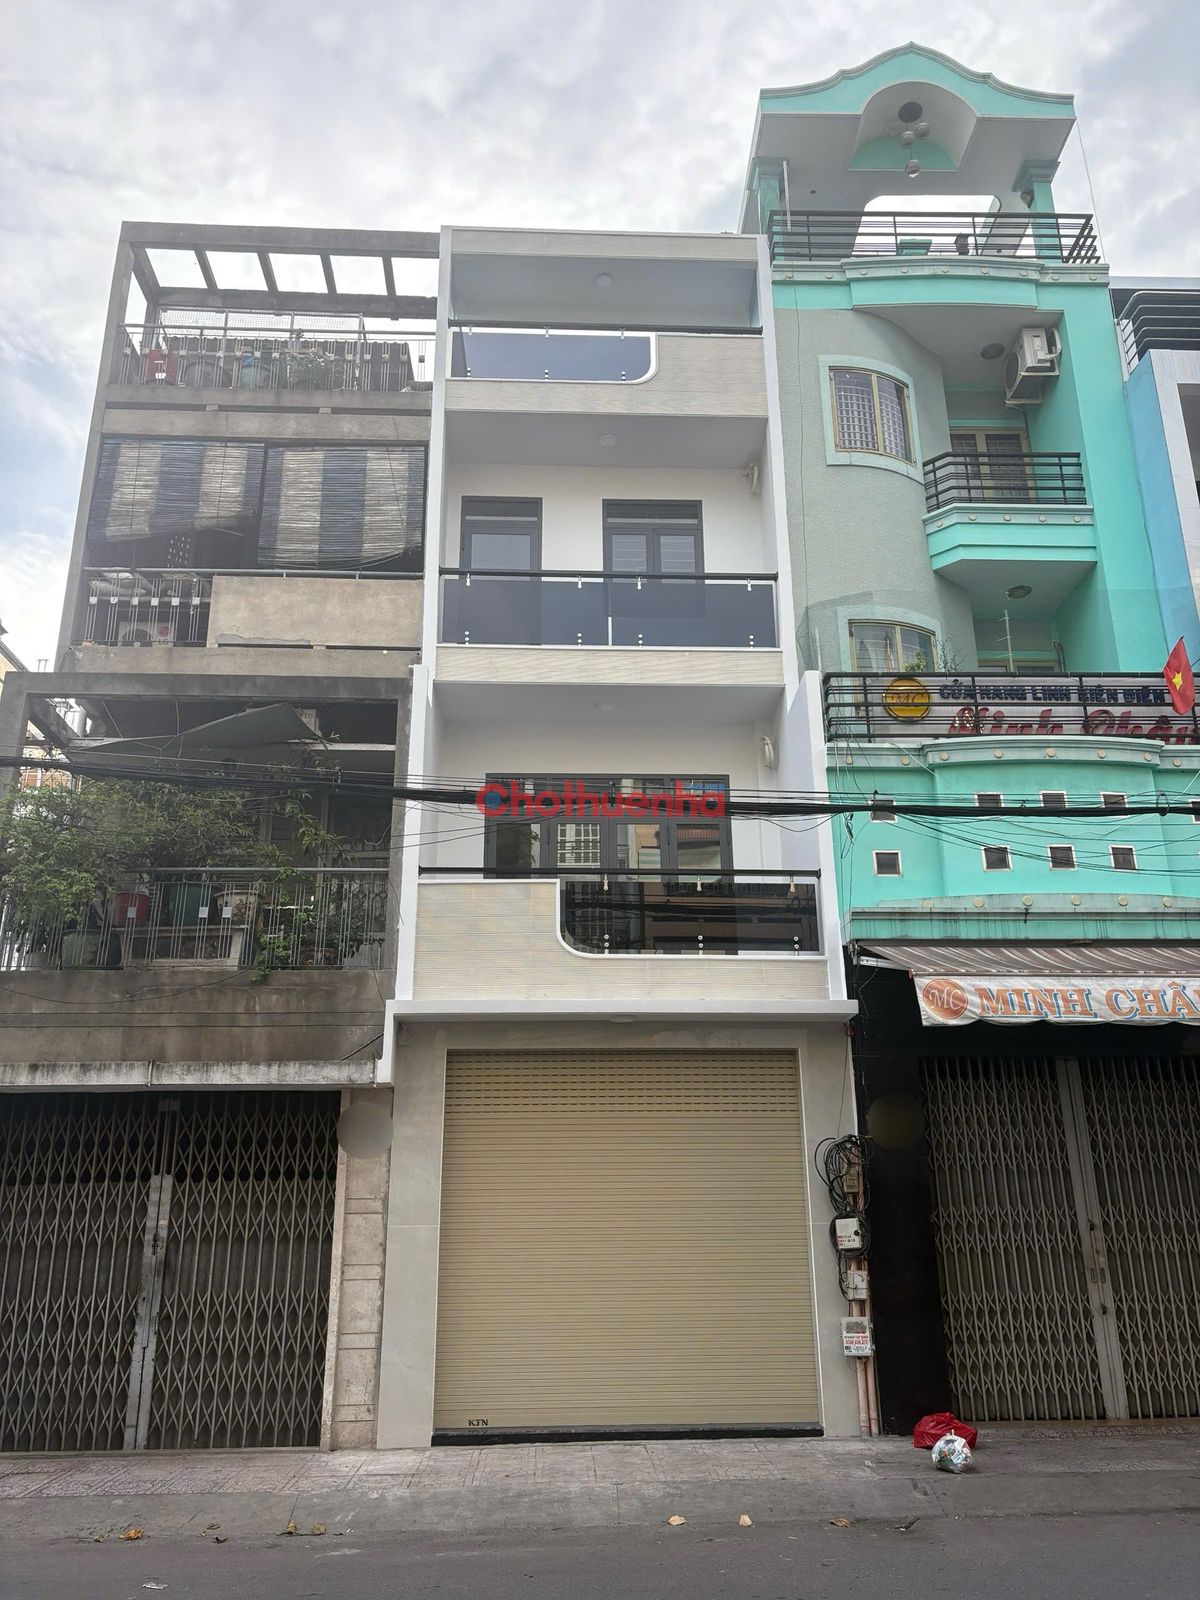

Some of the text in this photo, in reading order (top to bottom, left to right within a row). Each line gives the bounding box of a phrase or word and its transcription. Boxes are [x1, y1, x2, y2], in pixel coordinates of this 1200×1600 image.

[928, 980, 1200, 1020] MC MINH CHÂ
